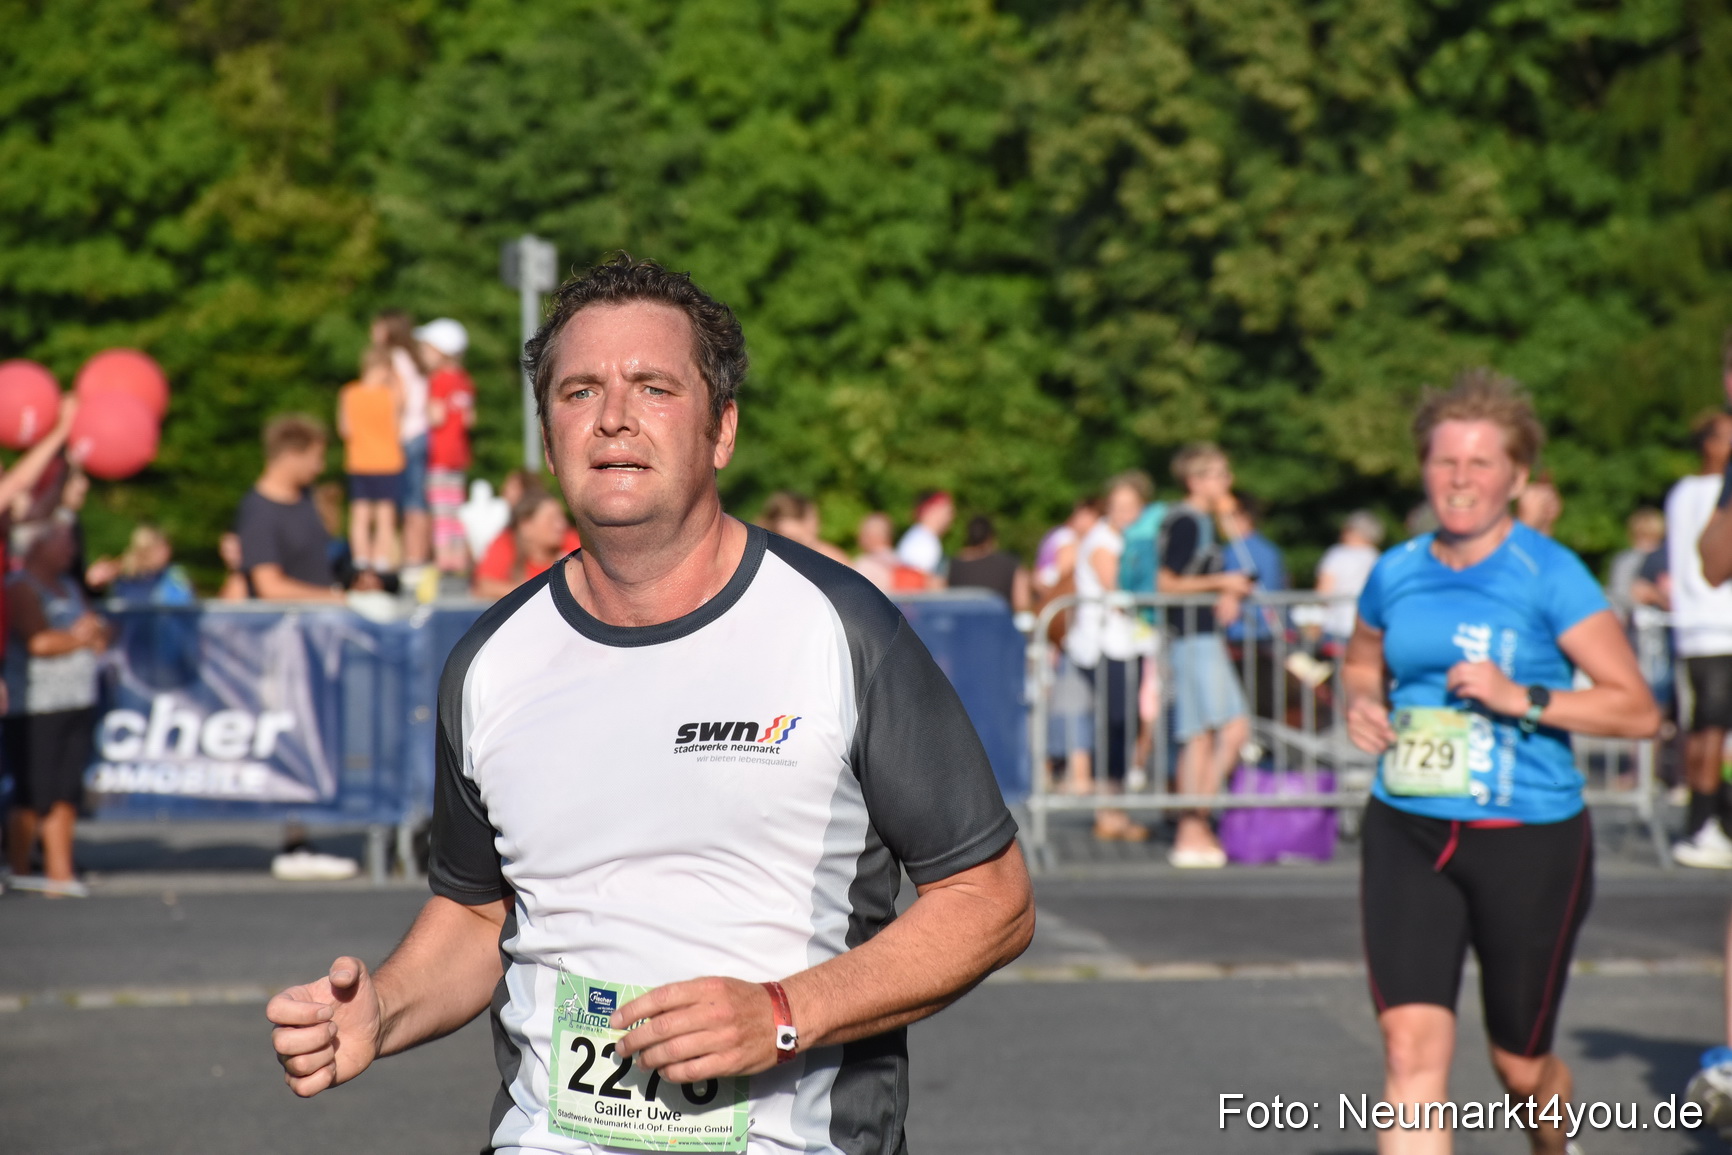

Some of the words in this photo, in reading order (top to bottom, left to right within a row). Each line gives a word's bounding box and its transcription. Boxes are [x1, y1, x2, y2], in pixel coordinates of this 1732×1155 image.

[675, 722, 759, 744] swn
[673, 743, 728, 754] stadtwerke
[730, 744, 780, 754] neumarkt
[557, 1109, 592, 1124] Stadtwerke
[594, 1116, 631, 1129] Neumarkt
[667, 1124, 702, 1134] Energie
[704, 1125, 733, 1133] GmbH
[594, 1101, 642, 1118] Gailler
[647, 1107, 682, 1121] Uwe
